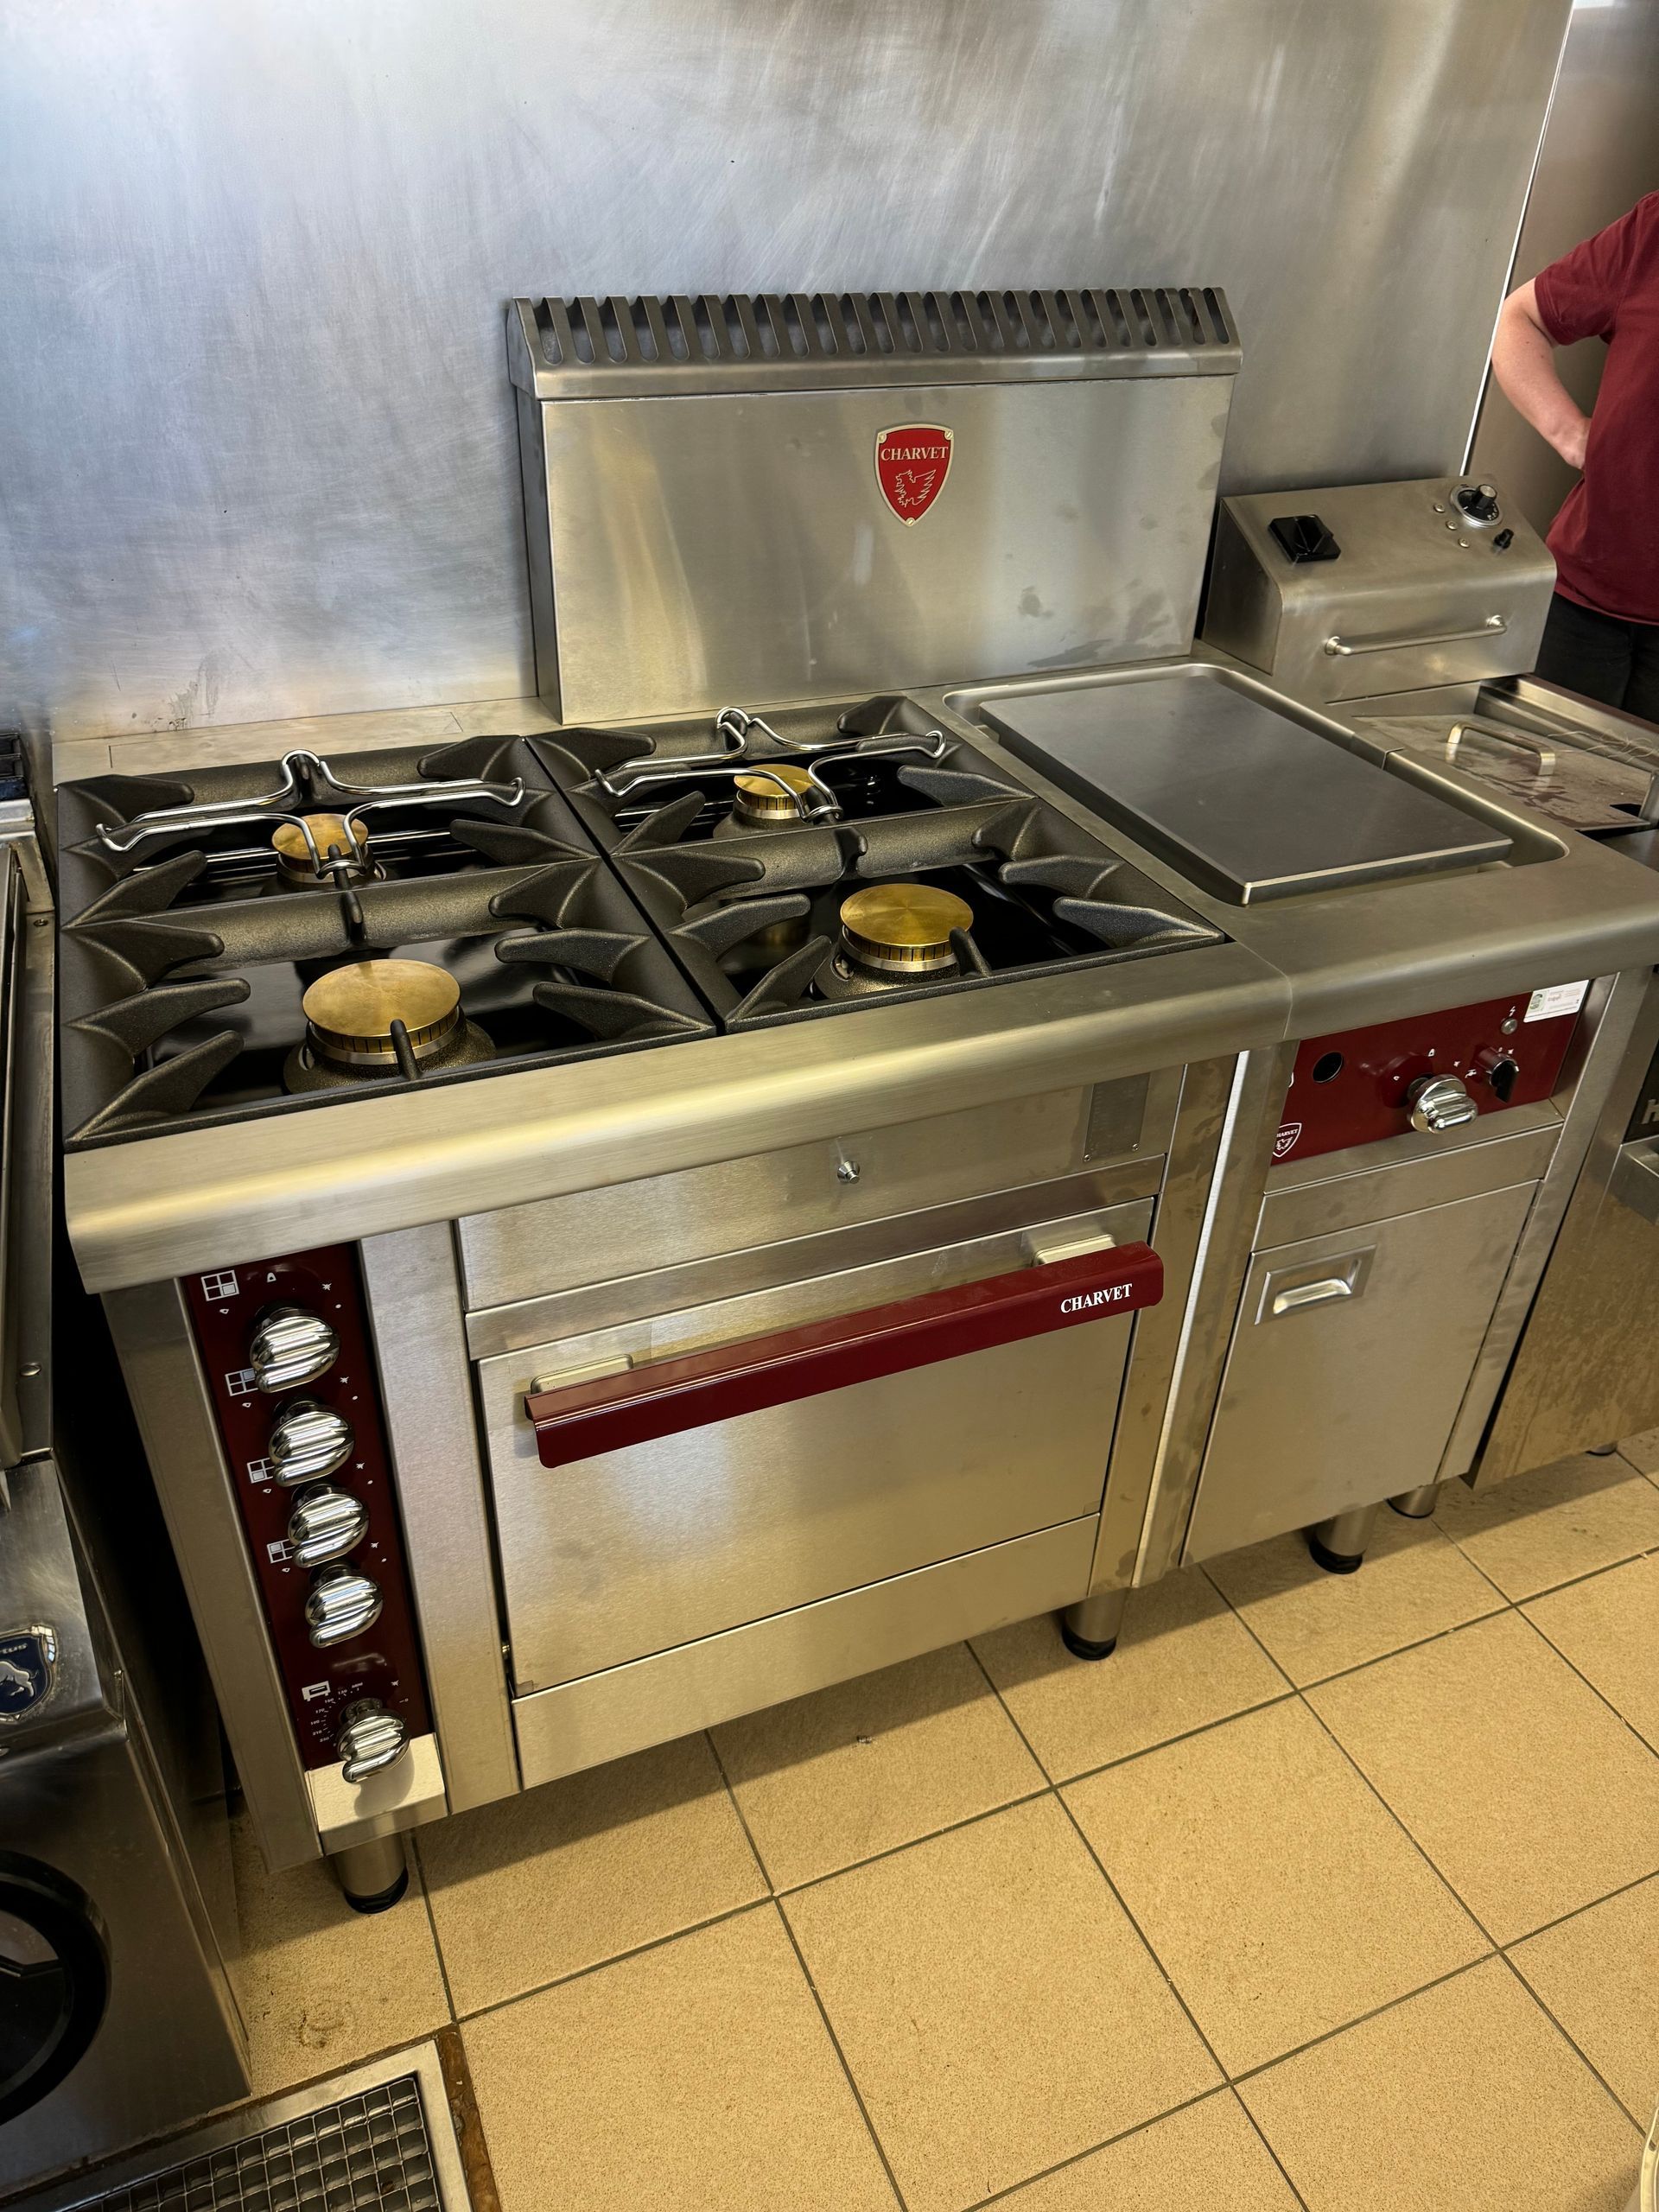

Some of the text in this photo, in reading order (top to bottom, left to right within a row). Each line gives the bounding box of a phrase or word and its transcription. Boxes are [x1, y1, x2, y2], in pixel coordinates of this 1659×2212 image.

[880, 447, 949, 461] CHARVET
[1276, 1128, 1299, 1138] HARVET
[1060, 1283, 1133, 1313] CHARVET
